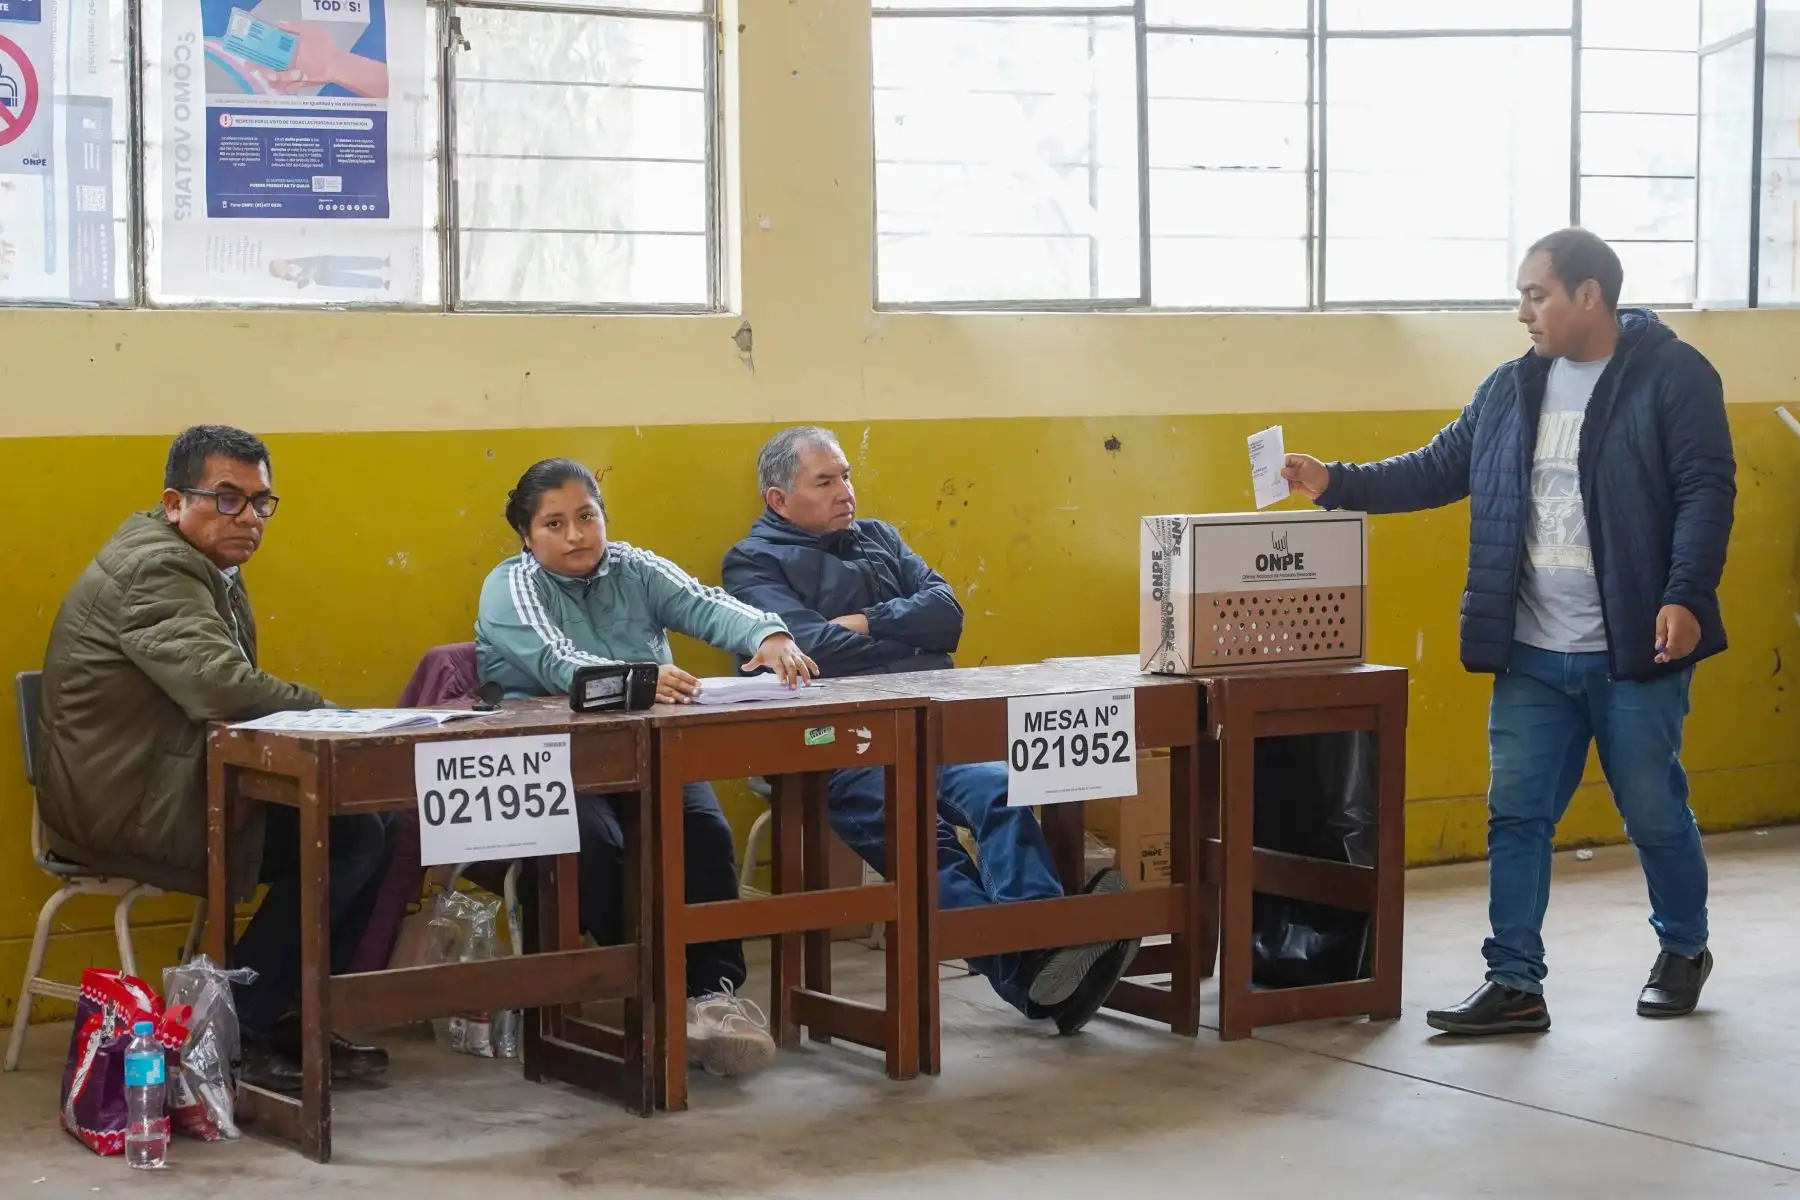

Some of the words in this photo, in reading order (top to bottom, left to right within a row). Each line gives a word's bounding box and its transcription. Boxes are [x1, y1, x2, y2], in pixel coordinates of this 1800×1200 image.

[22, 158, 47, 166] ONPE
[1255, 552, 1304, 572] ONPE
[1152, 550, 1163, 602] ONPE
[1024, 708, 1089, 733] MESA
[1011, 730, 1130, 772] 021952
[436, 754, 515, 781] MESA
[423, 781, 570, 827] 021952
